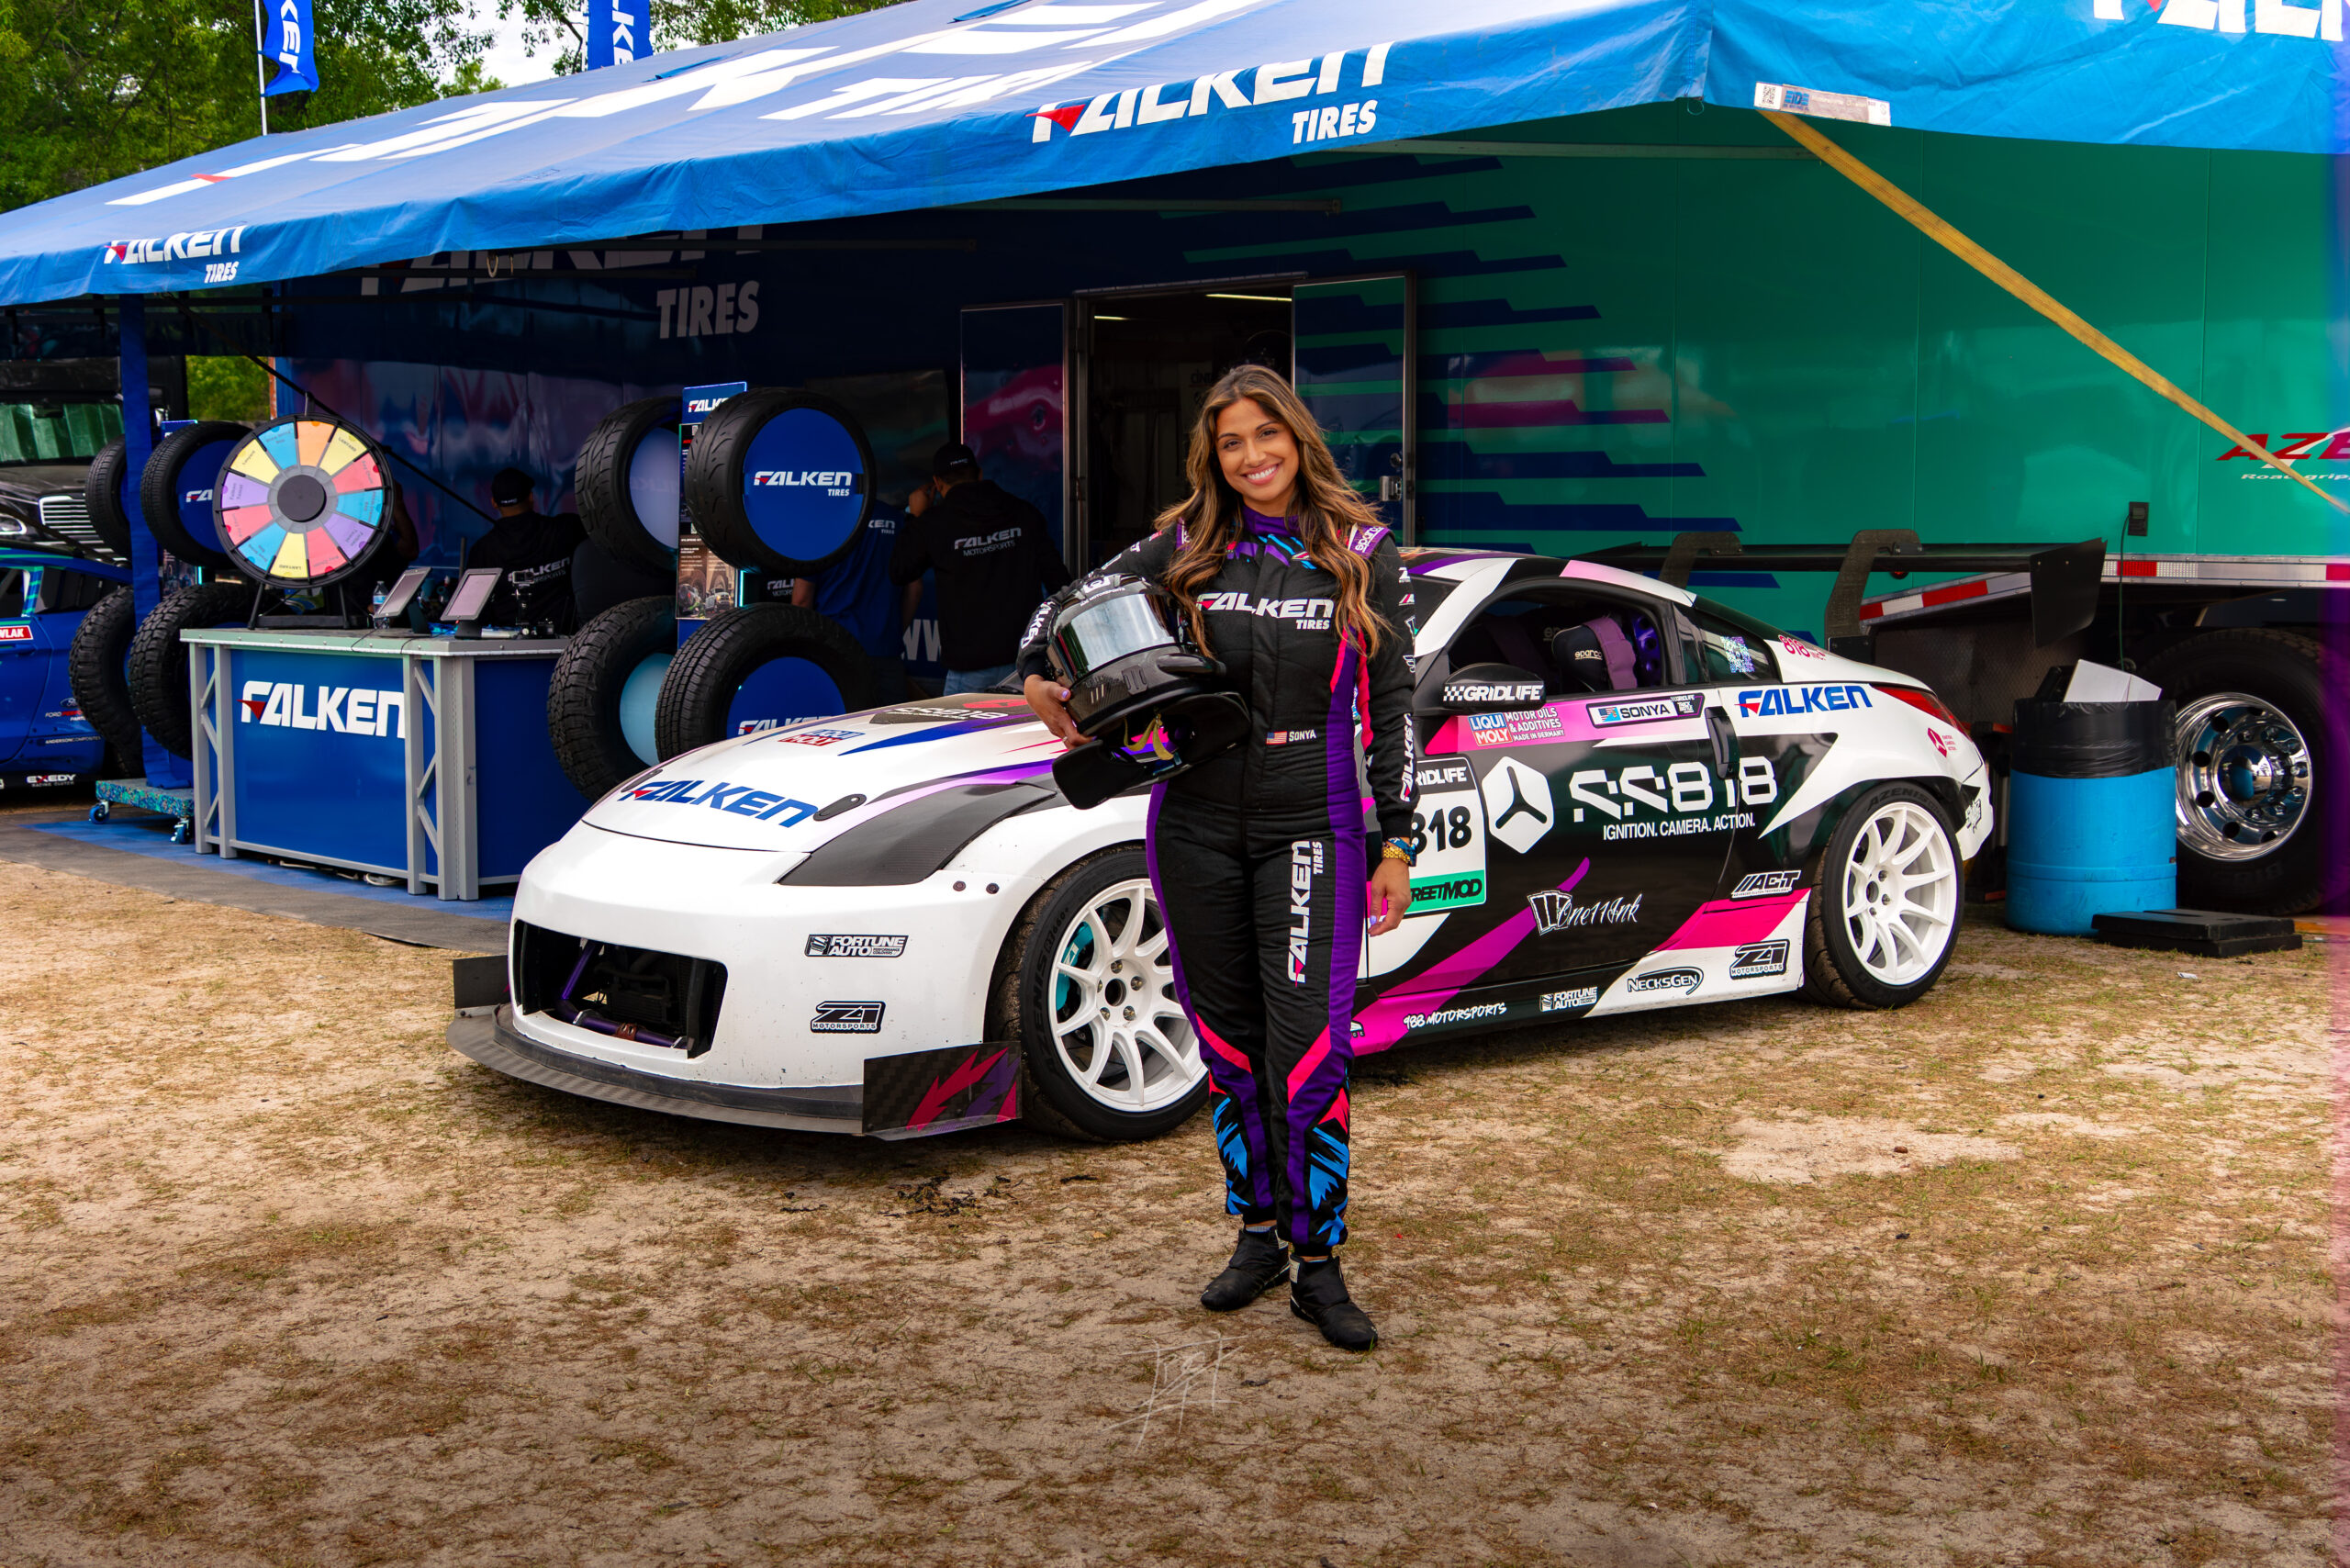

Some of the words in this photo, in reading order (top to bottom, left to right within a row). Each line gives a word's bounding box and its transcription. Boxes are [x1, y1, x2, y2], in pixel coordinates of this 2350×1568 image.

[1026, 41, 1395, 144] FALKEN
[1292, 100, 1379, 145] TIRES
[104, 225, 249, 264] FALKEN
[204, 261, 240, 284] TIRES
[656, 280, 760, 340] TIRES
[688, 398, 730, 413] FALK
[753, 471, 853, 486] FALKEN
[827, 488, 850, 497] TIRES
[955, 527, 1023, 551] FALKEN
[1196, 592, 1335, 619] FALKEN
[1295, 619, 1330, 630] TIRES
[1574, 648, 1603, 661] sparco
[1778, 634, 1811, 658] 818
[1462, 685, 1544, 701] GRIDLIFE
[1734, 685, 1874, 718] FALKEN
[238, 680, 405, 739] FALKEN
[1505, 710, 1537, 722] MOTOR
[1538, 707, 1558, 718] OILS
[1619, 703, 1671, 719] SONYA
[1470, 714, 1505, 731] LIQUI
[1508, 722, 1517, 733] &
[1517, 718, 1562, 732] ADDITIVES
[1289, 730, 1316, 742] SONYA
[1474, 729, 1510, 745] MOLY
[1513, 734, 1530, 742] MADE
[1537, 729, 1565, 739] GERMANY
[26, 773, 76, 784] EXEDY
[1415, 766, 1468, 786] RIDLIFE
[617, 779, 819, 828] FALKEN
[1411, 805, 1472, 856] 818
[1604, 822, 1658, 841] IGNITION.
[1660, 817, 1712, 837] CAMERA.
[1713, 812, 1756, 832] ACTION.
[1313, 841, 1324, 875] TIRES
[1410, 878, 1483, 902] REETMOD
[1287, 840, 1312, 986] FALKEN
[830, 935, 906, 947] FORTUNE
[826, 946, 872, 957] AUTO
[1731, 963, 1784, 975] MOTORSPORTS
[1553, 986, 1598, 1002] FORTUNE
[1554, 998, 1580, 1010] AUTO
[1404, 1013, 1426, 1030] 988
[1426, 1002, 1507, 1025] MOTORSPORTS
